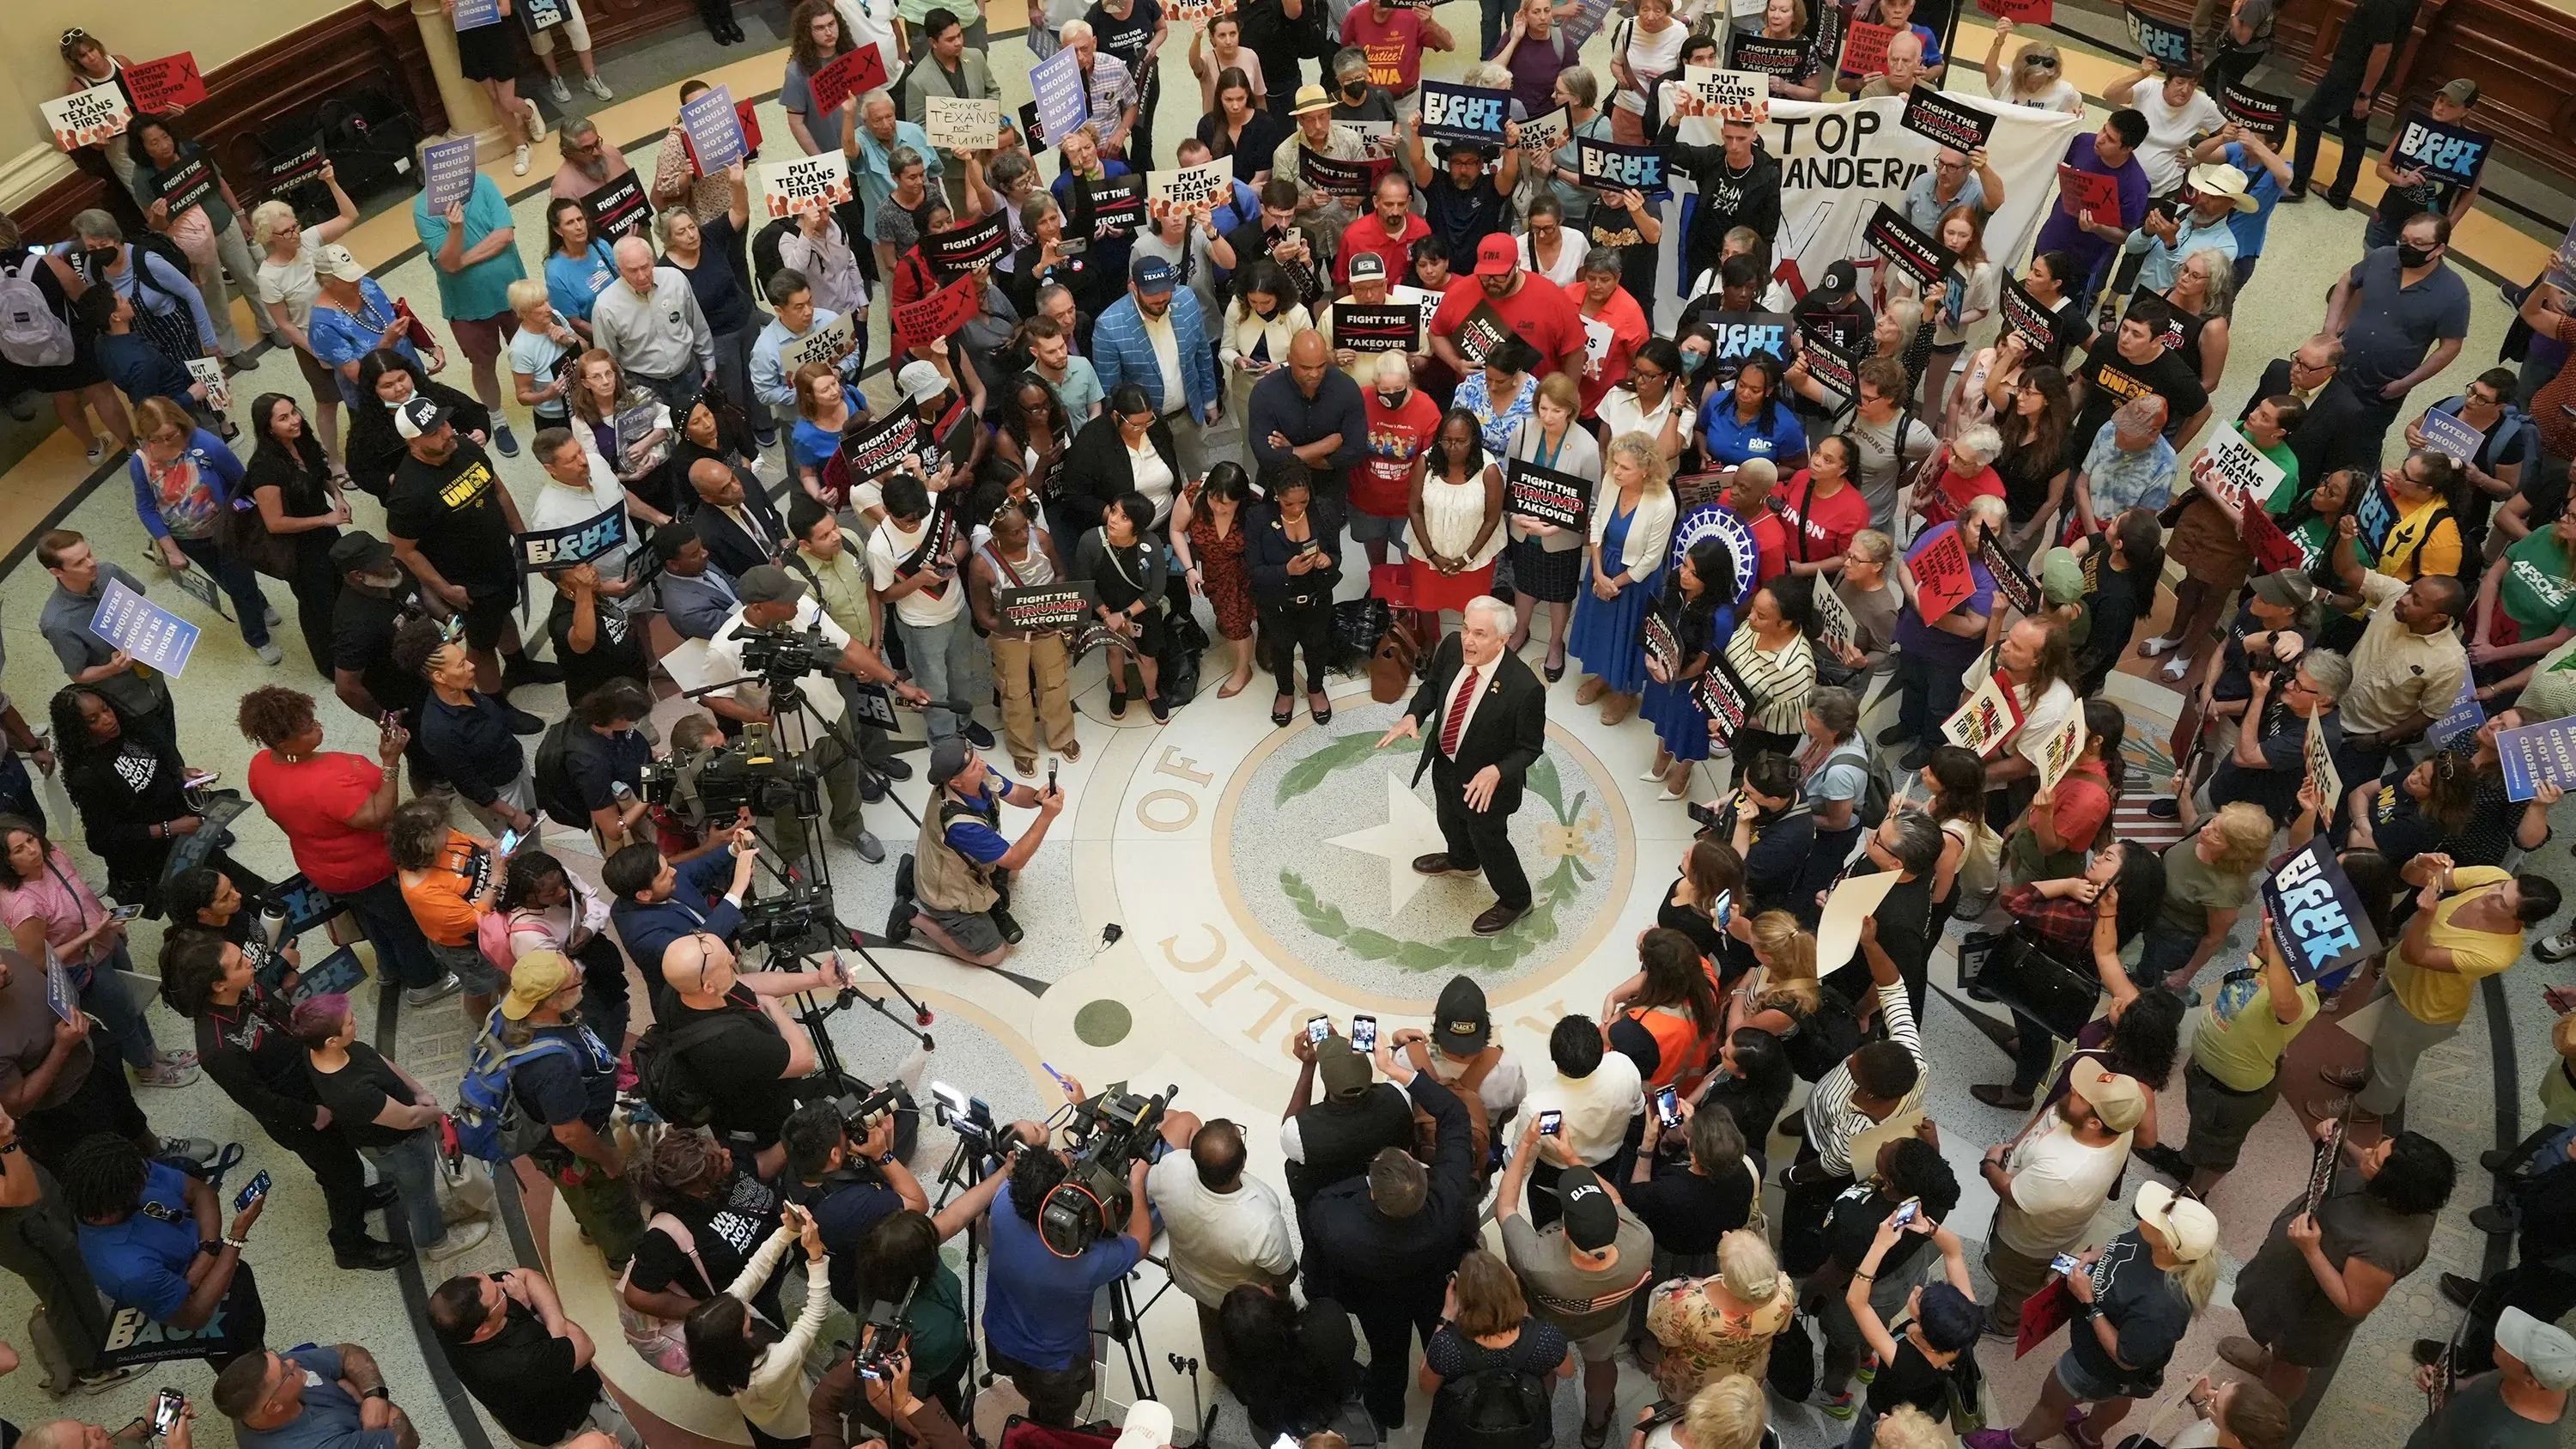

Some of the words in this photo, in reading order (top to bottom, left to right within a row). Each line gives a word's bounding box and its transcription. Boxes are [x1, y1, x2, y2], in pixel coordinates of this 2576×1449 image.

[459, 4, 491, 17] CHOSEN
[1109, 33, 1148, 48] DEMOCRACY
[1113, 32, 1130, 42] VETS
[1129, 28, 1142, 39] FOR
[1364, 43, 1405, 62] Justice!
[1746, 44, 1776, 56] FIGHT
[1777, 47, 1797, 56] THE
[1036, 55, 1071, 81] VOTERS
[1712, 73, 1741, 85] PUT
[1741, 62, 1793, 74] TAKEOVER
[1040, 68, 1074, 94] SHOULD
[1698, 83, 1755, 97] TEXANS
[59, 99, 113, 123] TEXANS
[67, 94, 94, 109] PUT
[687, 94, 724, 117] VOTERS
[939, 98, 981, 109] Serve
[1048, 101, 1067, 118] NOT
[1067, 93, 1078, 104] BE
[1425, 91, 1503, 113] FIGHT
[1706, 94, 1746, 106] FIRST
[2225, 87, 2254, 106] FIGHT
[2255, 100, 2278, 113] THE
[72, 113, 108, 130] FIRST
[693, 106, 727, 129] SHOULD
[931, 110, 996, 125] TEXANS
[1049, 103, 1081, 130] CHOSEN
[1424, 107, 1503, 132] BACK
[1910, 105, 1982, 143] TRUMP
[1922, 100, 1954, 118] FIGHT
[1954, 112, 1978, 130] THE
[953, 124, 973, 132] not
[1771, 111, 1880, 156] TOP
[1913, 119, 1970, 150] TAKEOVER
[431, 143, 469, 159] VOTERS
[705, 138, 739, 161] CHOSEN
[2409, 122, 2482, 159] FIGHT
[273, 155, 300, 174] FIGHT
[301, 146, 318, 160] THE
[433, 155, 470, 170] SHOULD
[788, 161, 817, 176] PUT
[1308, 157, 1334, 176] FIGHT
[1336, 170, 1358, 179] THE
[2399, 141, 2478, 176] BACK
[163, 171, 185, 191] FIGHT
[185, 160, 202, 175] THE
[458, 178, 469, 187] BE
[775, 168, 835, 188] TEXANS
[1163, 175, 1220, 193] TEXANS
[1178, 168, 1206, 182] PUT
[171, 182, 210, 212] TAKEOVER
[596, 193, 620, 211] FIGHT
[619, 183, 635, 198] THE
[789, 181, 827, 198] FIRST
[1109, 187, 1130, 198] THE
[1173, 188, 1212, 202] FIRST
[608, 207, 647, 234] TAKEOVER
[943, 235, 977, 250] FIGHT
[978, 225, 999, 240] THE
[1885, 221, 1917, 247] FIGHT
[1917, 242, 1940, 265] THE
[946, 247, 1003, 270] TAKEOVER
[1483, 251, 1500, 260] CWA
[1875, 237, 1926, 283] TAKEOVER
[1144, 272, 1164, 281] TEXAS
[899, 295, 949, 317] ABBOTT'S
[1421, 295, 1440, 307] PU
[2008, 286, 2031, 314] FIGHT
[2029, 309, 2049, 329] THE
[1346, 315, 1381, 325] FIGHT
[1382, 315, 1406, 325] THE
[1477, 318, 1505, 343] FIGHT
[805, 328, 830, 349] PUT
[1346, 338, 1406, 348] TAKEOVER
[1716, 323, 1783, 344] IGHT
[793, 329, 844, 363] TEXANS
[1809, 338, 1832, 360] FIGHT
[1830, 353, 1848, 369] THE
[191, 364, 207, 376] PUT
[1811, 364, 1852, 395] TAKEOVER
[2104, 363, 2117, 374] TEXAS
[2116, 369, 2129, 380] STATE
[2129, 375, 2154, 392] EMPLOYEES
[2098, 368, 2152, 398] UNION
[858, 430, 892, 452] FIGHT
[891, 414, 911, 433] THE
[2433, 417, 2474, 445] VOTERS
[864, 437, 918, 475] TAKEOVER
[921, 446, 939, 460] WE
[2233, 442, 2259, 466] PUT
[2427, 431, 2466, 458] SHOULD
[2216, 460, 2250, 490] FIRST
[2218, 443, 2263, 488] TEXANS
[439, 482, 453, 496] TEXAS
[453, 475, 464, 488] STATE
[441, 465, 492, 508] UNION
[1510, 480, 1583, 514] TRUMP
[1521, 473, 1555, 490] FIGHT
[1555, 484, 1578, 497] THE
[1516, 498, 1575, 525] TAKEOVER
[1781, 504, 1826, 539] UNON
[526, 514, 618, 552] FIGHT
[1946, 535, 1964, 575] ABBOTT'S
[2512, 560, 2569, 606] AFSCME
[99, 590, 124, 630] VOTERS
[1005, 600, 1086, 619] TRUMP
[1016, 594, 1054, 605] FIGHT
[1055, 592, 1079, 600] THE
[112, 600, 136, 639] SHOULD
[1013, 614, 1078, 626] TAKEOVER
[139, 633, 154, 654] NOT
[153, 617, 163, 631] BE
[154, 622, 179, 662] CHOSEN
[1713, 666, 1735, 696] FIGHT
[1731, 691, 1747, 711] THE
[1702, 691, 1734, 739] TAKEOVER
[2436, 715, 2457, 729] NOT
[2459, 709, 2473, 721] BE
[1953, 718, 1969, 739] FOR
[2535, 735, 2549, 758] NOT
[2549, 728, 2576, 783] CHOOSE,
[128, 766, 146, 788] NOT
[135, 778, 150, 794] FOR
[1136, 744, 1207, 825] OF
[2293, 848, 2360, 951] FIGHT
[2275, 870, 2342, 970] BACK
[1571, 1185, 1602, 1202] BETO
[720, 1215, 739, 1240] FOR
[729, 1218, 750, 1247] NOT
[738, 1233, 753, 1254] FOR
